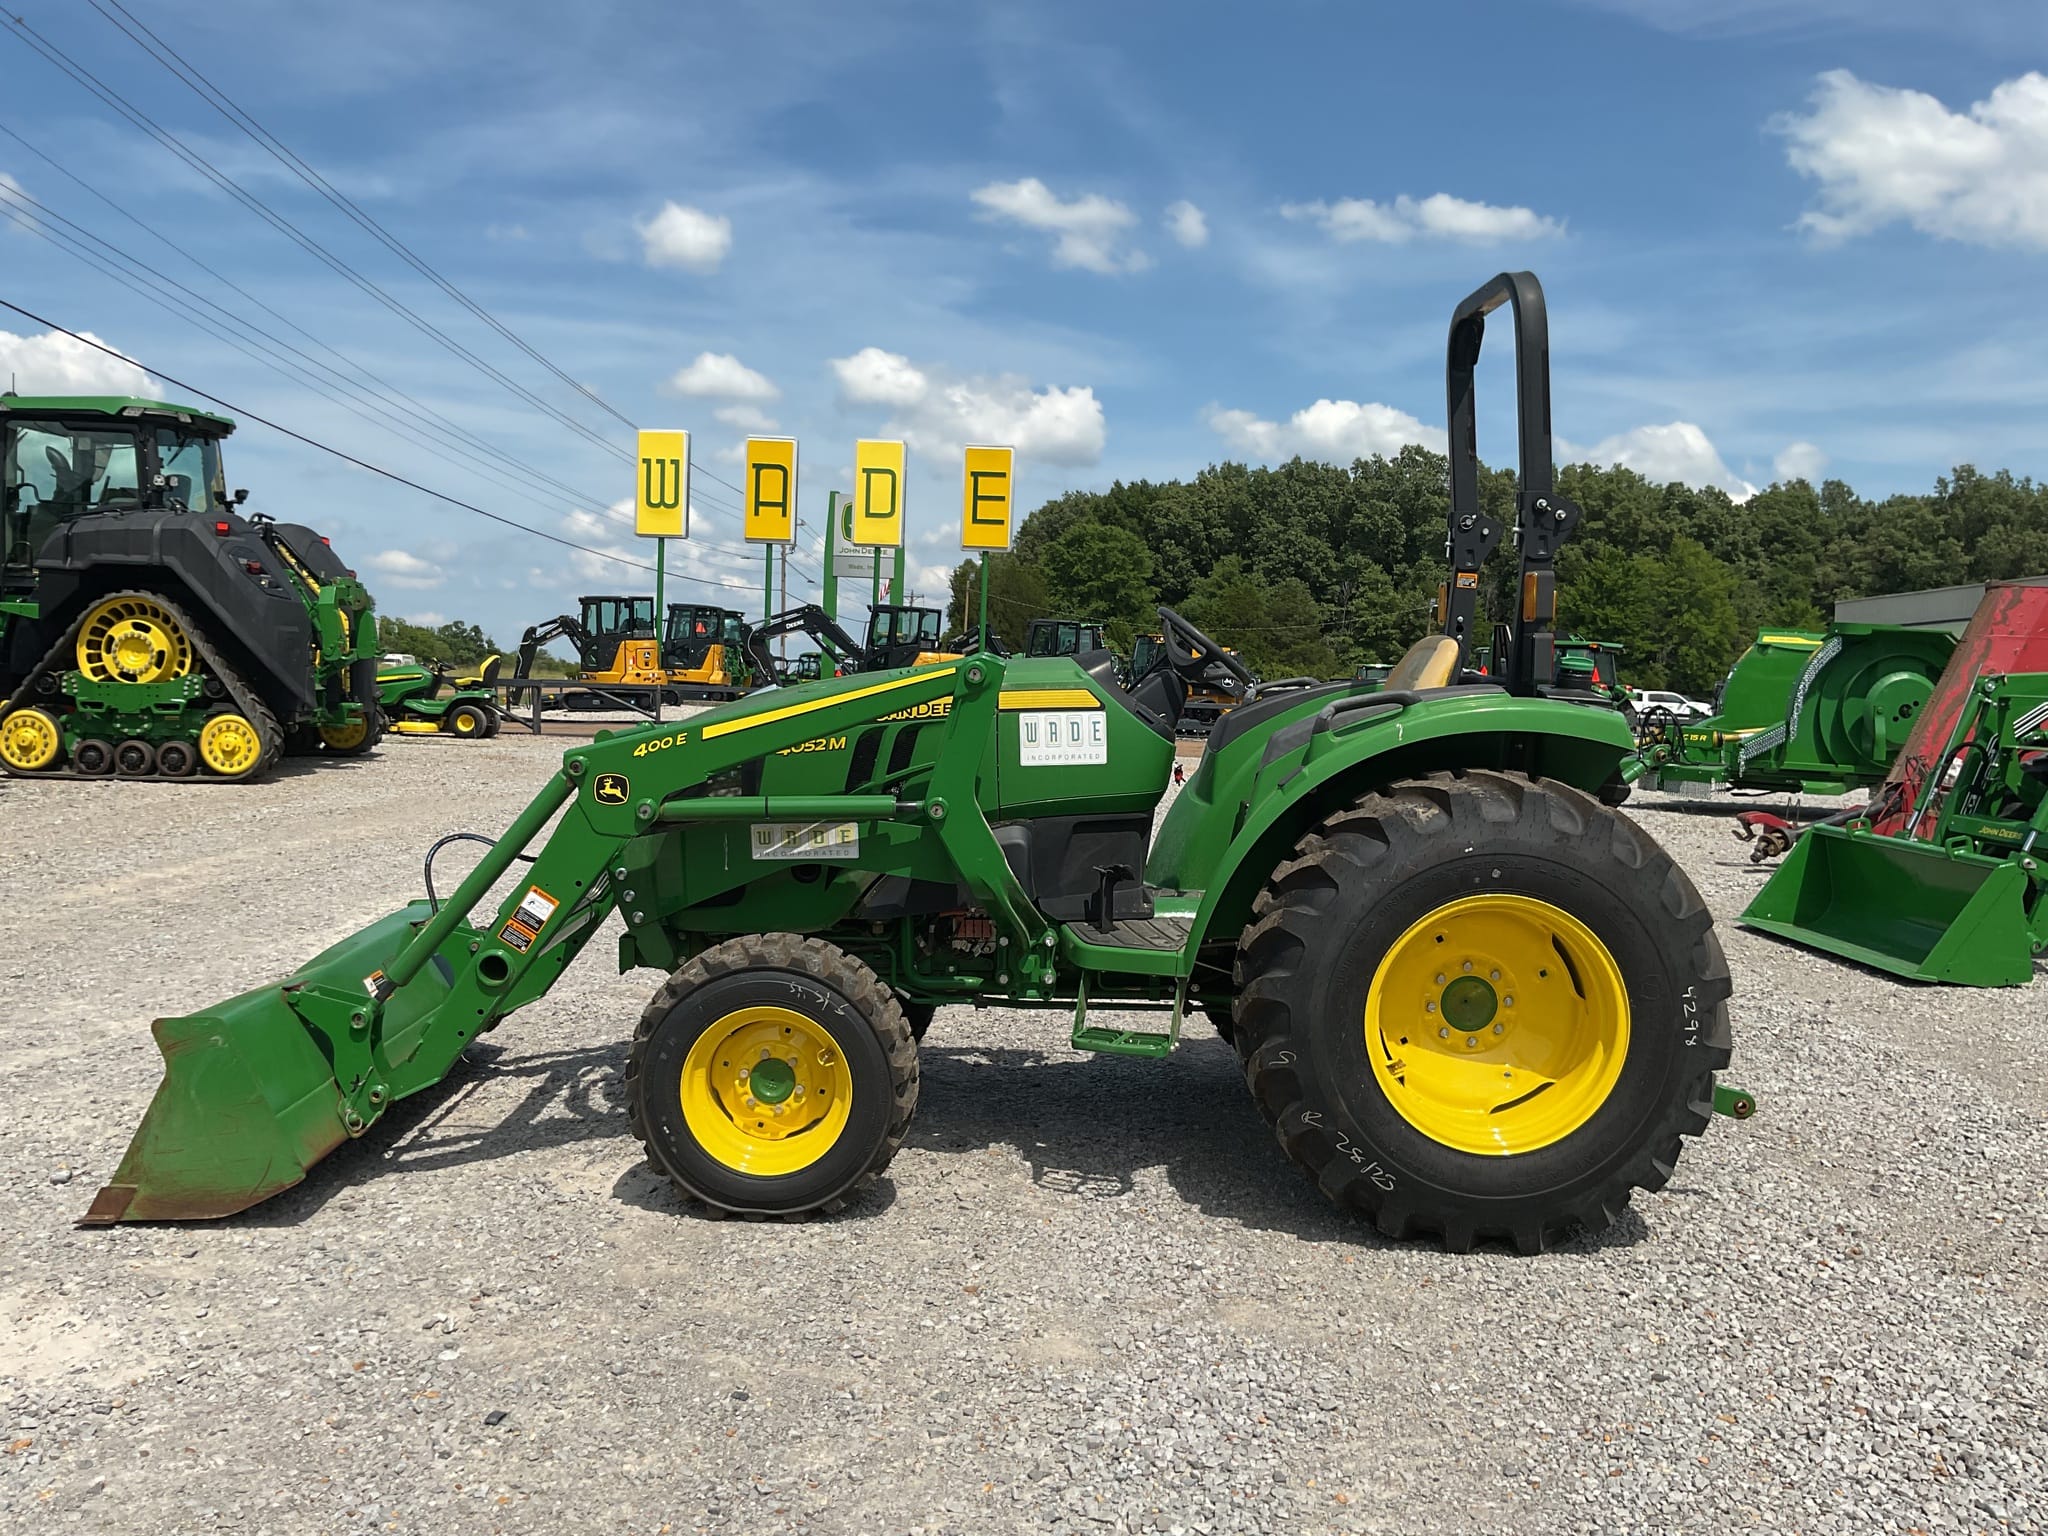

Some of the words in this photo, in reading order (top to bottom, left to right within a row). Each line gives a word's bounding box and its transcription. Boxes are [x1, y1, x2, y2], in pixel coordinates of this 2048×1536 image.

[1027, 753, 1100, 761] INCORPORATED
[1979, 825, 1998, 836] JOHN
[760, 849, 849, 857] INCORPORATED
